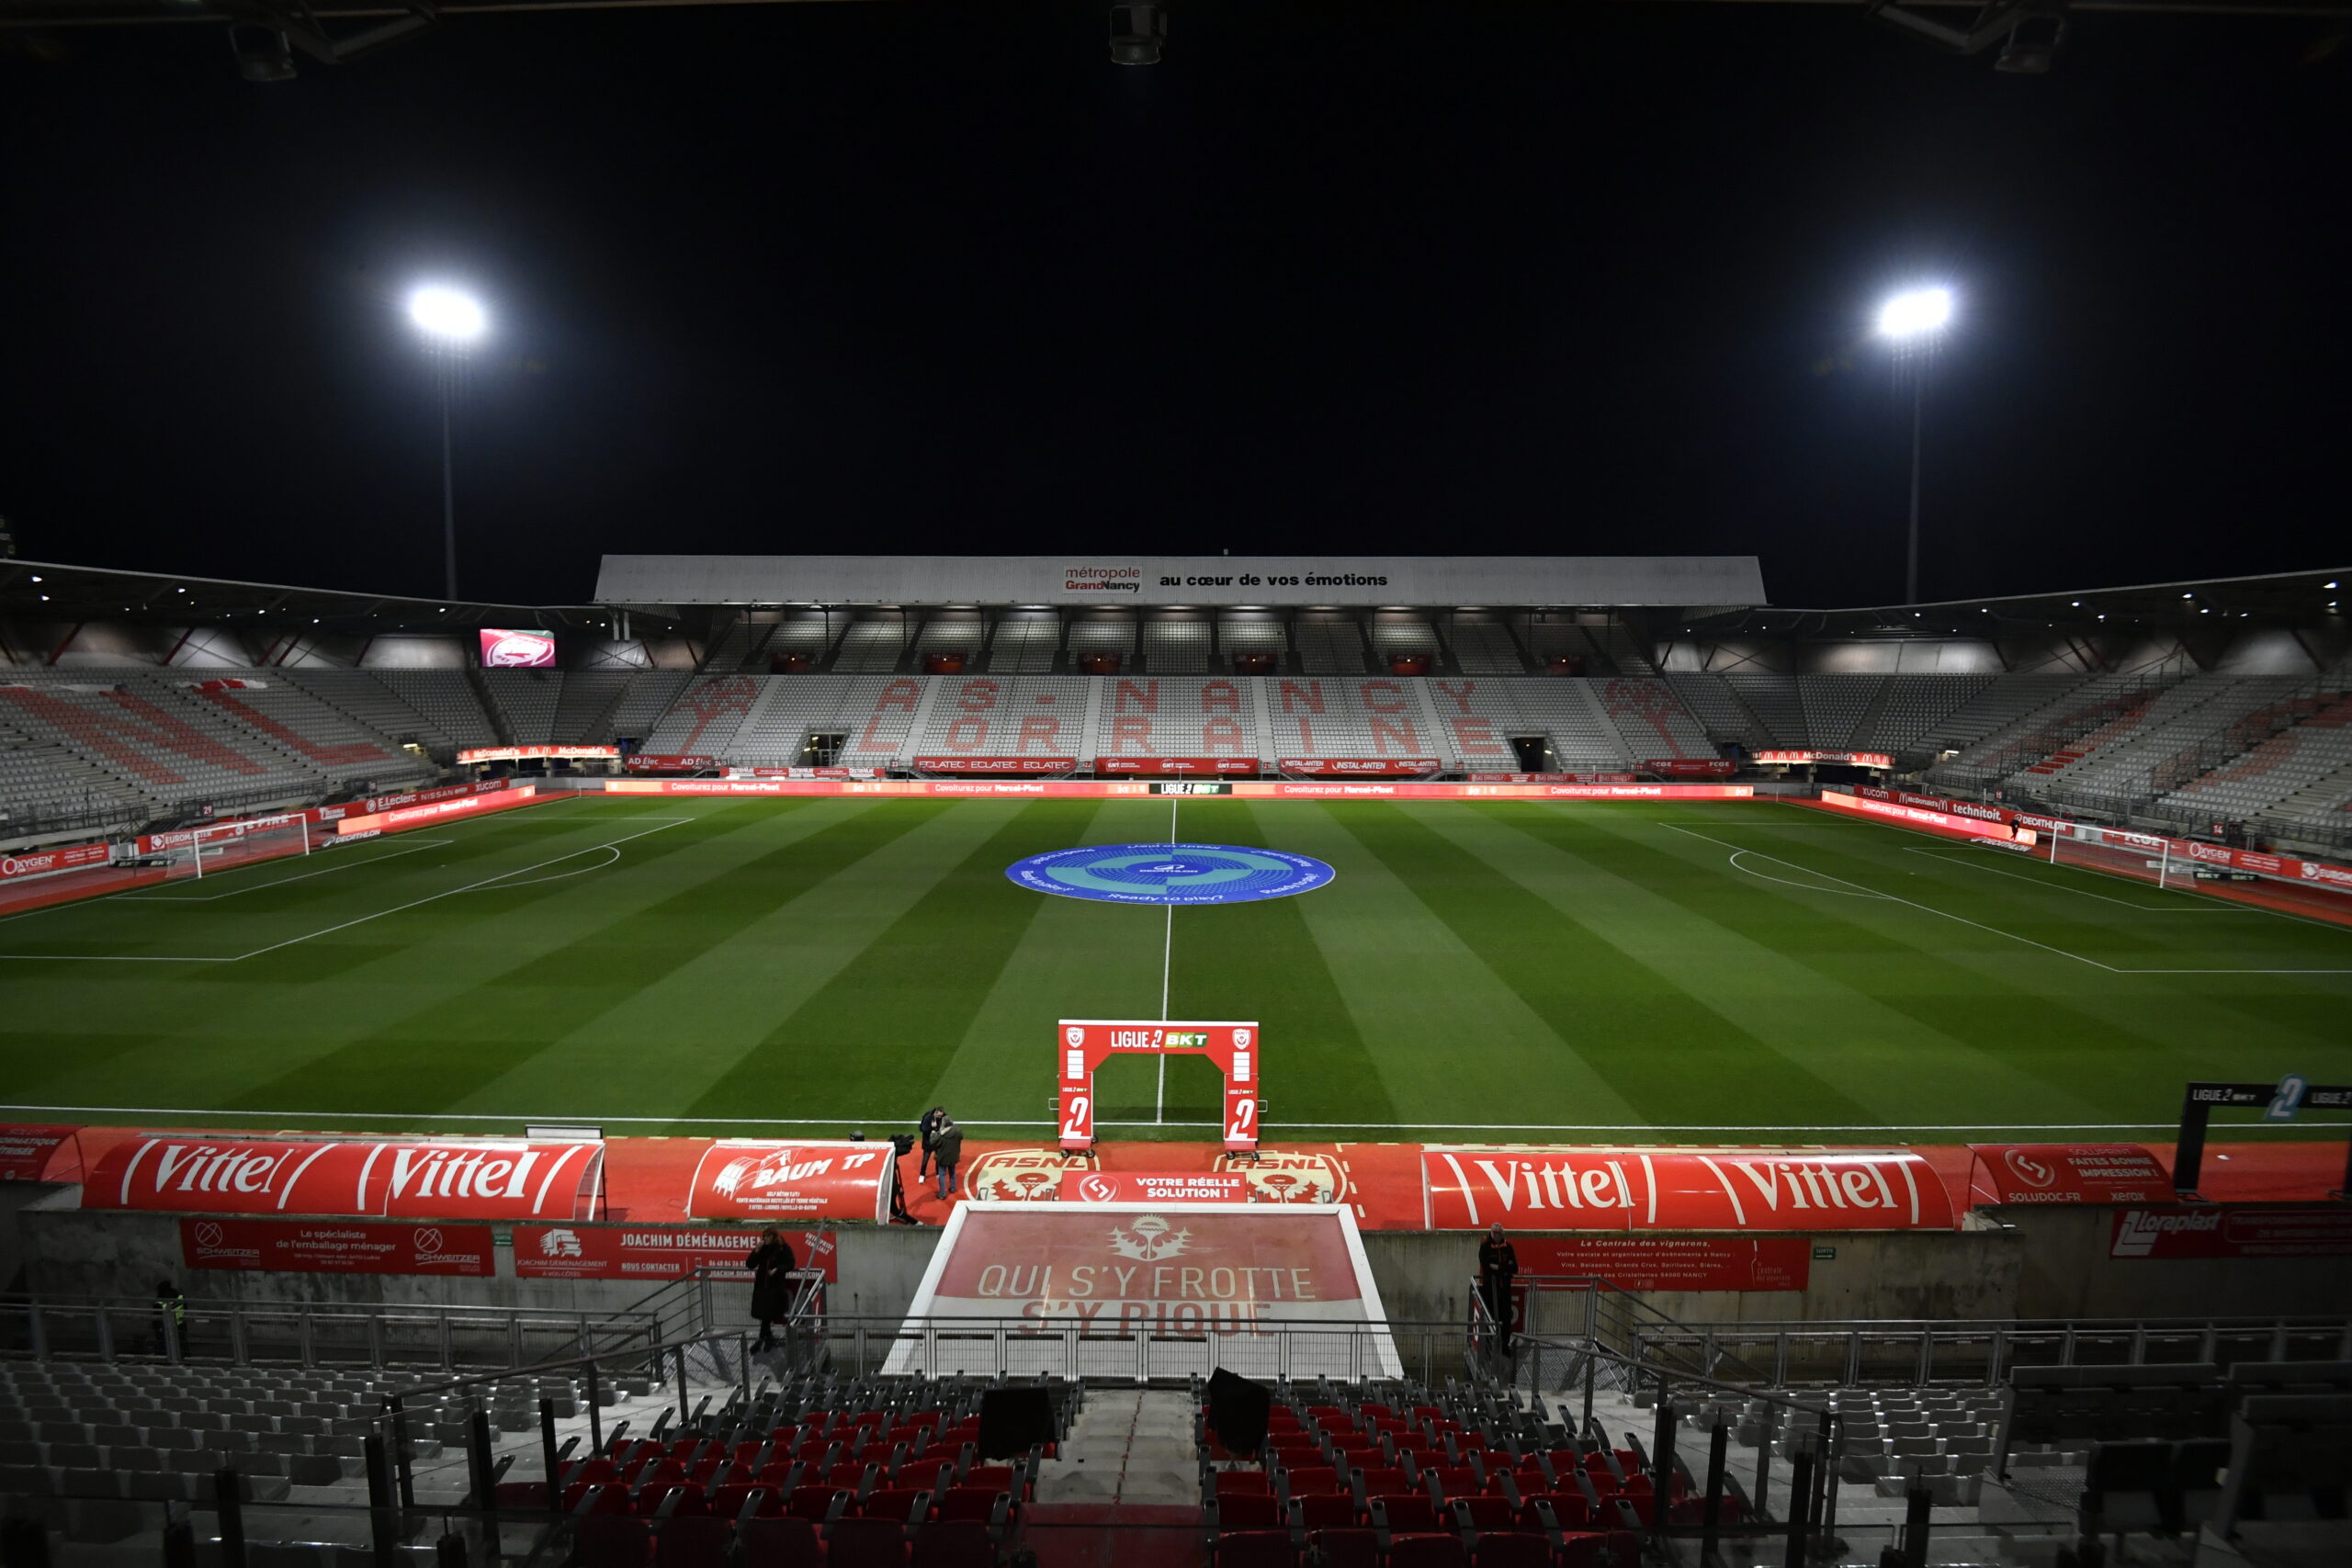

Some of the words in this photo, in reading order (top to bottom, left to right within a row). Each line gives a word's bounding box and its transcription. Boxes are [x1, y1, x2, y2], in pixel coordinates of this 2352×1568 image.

[1066, 567, 1140, 580] métropole
[1159, 575, 1181, 586] au
[1186, 574, 1233, 586] cœur
[1239, 573, 1261, 586] de
[1267, 575, 1299, 586] vos
[1305, 571, 1388, 586] émotions
[1066, 581, 1140, 593] GrandNancy
[857, 716, 1504, 754] LORRAINE
[643, 756, 659, 765] Élec
[1804, 751, 1858, 761] McDonald's
[1337, 761, 1386, 770] INSTAL-ANTEN
[475, 780, 502, 792] xucom
[672, 783, 711, 791] Covoiturez
[1161, 784, 1185, 795] LIGUE
[421, 790, 454, 801] NISSAN
[1862, 787, 1889, 799] xucom
[378, 794, 416, 807] E.Leclerc
[1907, 796, 1939, 807] McDonald's
[203, 806, 212, 815] 29
[424, 806, 438, 817] pour
[1893, 807, 1905, 817] pour
[1953, 804, 2002, 821] technitoit.
[2213, 825, 2223, 834] 14
[1108, 893, 1156, 901] Ready
[1111, 1031, 1149, 1048] LIGUE
[1151, 1029, 1163, 1048] 2
[1165, 1032, 1207, 1047] BKT
[2192, 1089, 2222, 1100] LIGUE
[2222, 1089, 2233, 1100] 2
[1062, 1097, 1089, 1139] 2
[1227, 1099, 1255, 1140] 2
[156, 1145, 294, 1192] Vittel
[989, 1156, 1087, 1169] ASNL
[1229, 1158, 1326, 1171] ASNL
[392, 1149, 540, 1199] Vittel
[752, 1158, 833, 1189] BAUM
[842, 1153, 876, 1170] TP
[2079, 1168, 2151, 1177] IMPRESSION
[1136, 1178, 1184, 1188] VOTRE
[1187, 1176, 1240, 1188] RÉELLE
[1473, 1161, 1635, 1211] Vittel
[1731, 1162, 1898, 1211] Vittel
[1147, 1188, 1220, 1199] SOLUTION
[2008, 1192, 2081, 1202] SOLUDOC.FR
[2110, 1192, 2146, 1202] xerox
[2136, 1210, 2222, 1235] Loraplast
[300, 1230, 312, 1238] Le
[314, 1229, 367, 1241] spécialiste
[620, 1234, 672, 1247] JOACHIM
[277, 1240, 288, 1248] de
[291, 1241, 347, 1252] l'emballage
[350, 1243, 397, 1253] ménager
[1660, 1240, 1711, 1249] vignerons,
[197, 1247, 260, 1258] SCHWEITZER
[415, 1254, 481, 1262] SCHWEITZER
[549, 1259, 608, 1268] DÉMÉNAGEMENT
[621, 1262, 639, 1271] NOUS
[641, 1263, 680, 1272] CONTACTER
[978, 1265, 1052, 1296] QUI
[1069, 1266, 1137, 1298] S'Y
[1154, 1267, 1316, 1299] FROTTE
[1017, 1301, 1104, 1336] S'Y
[1120, 1302, 1274, 1338] PIQUE
